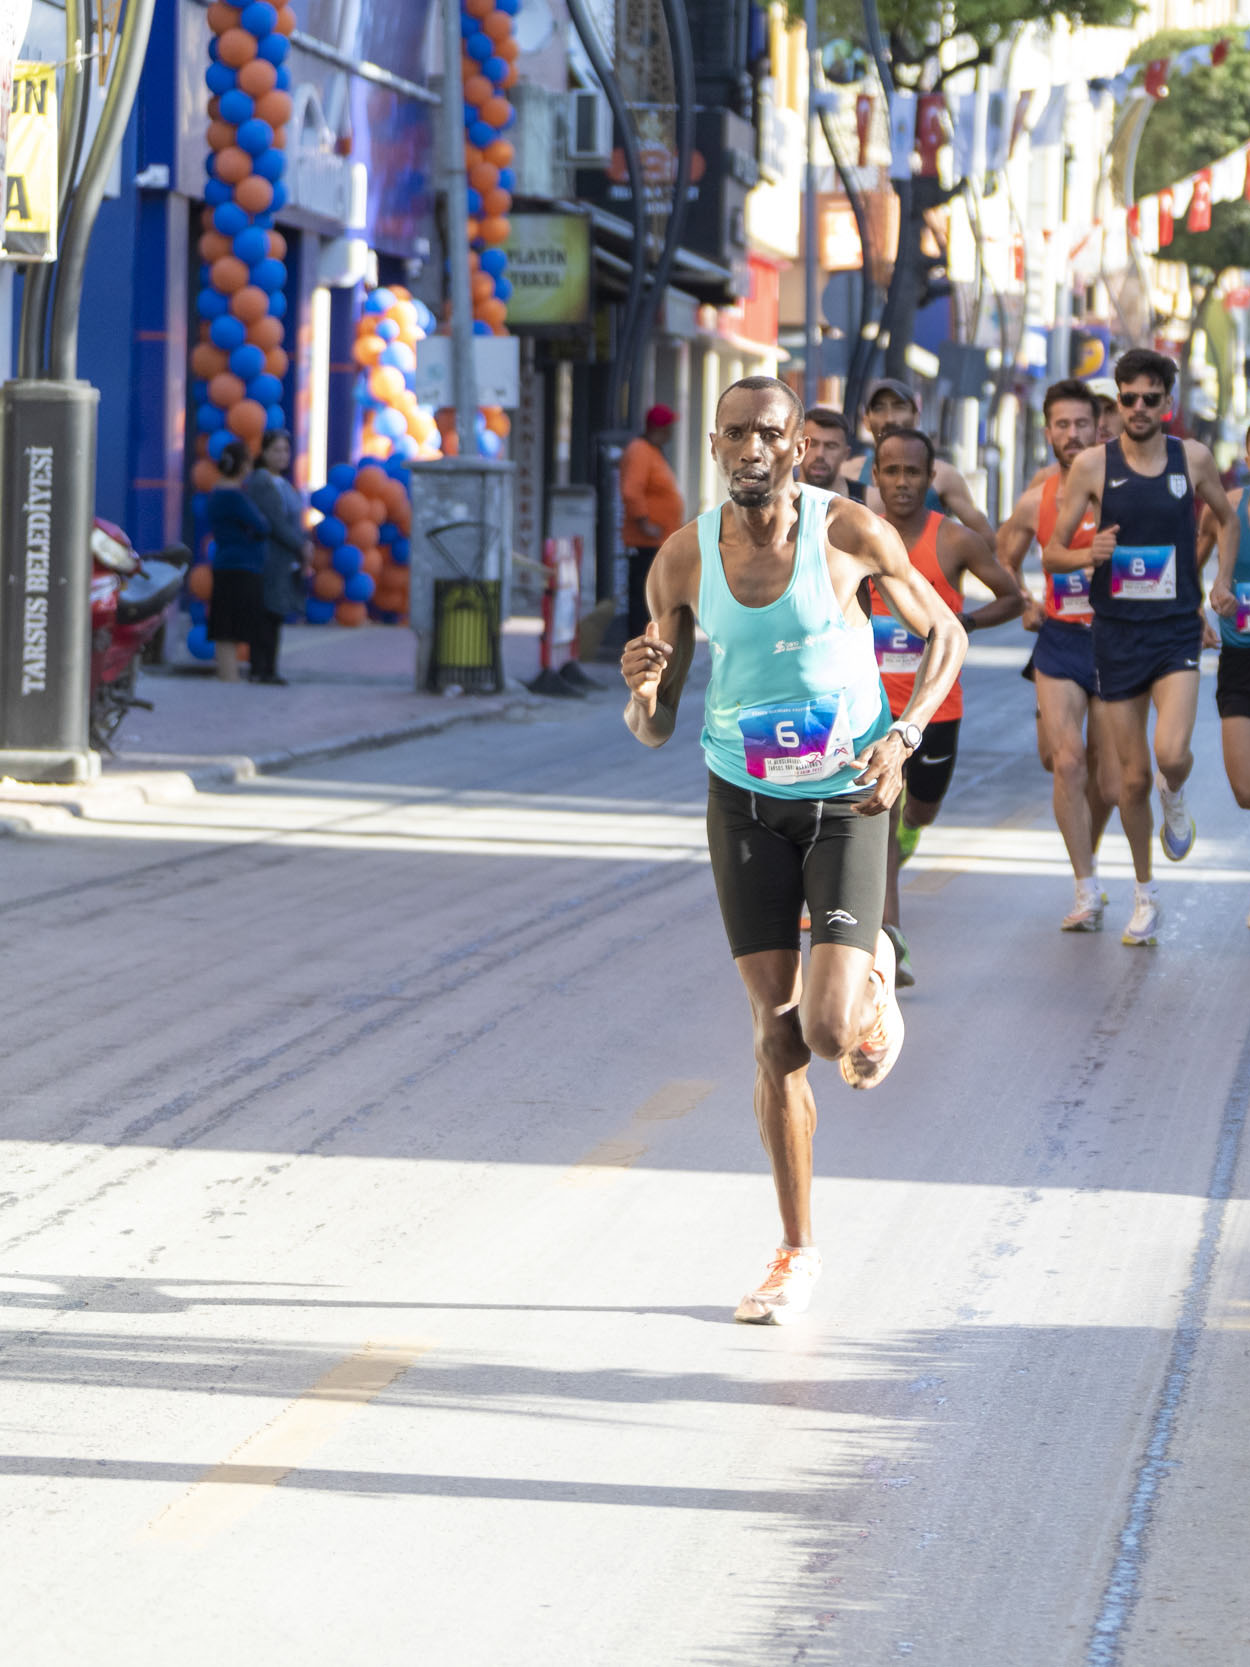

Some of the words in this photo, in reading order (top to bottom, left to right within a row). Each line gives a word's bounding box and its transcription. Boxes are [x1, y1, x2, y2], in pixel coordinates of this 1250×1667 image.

[23, 446, 53, 593] BELEDİYESİ
[1132, 558, 1146, 577] 8
[1069, 575, 1083, 593] 5
[22, 597, 48, 694] TARSUS
[892, 629, 909, 649] 2
[776, 721, 799, 747] 6
